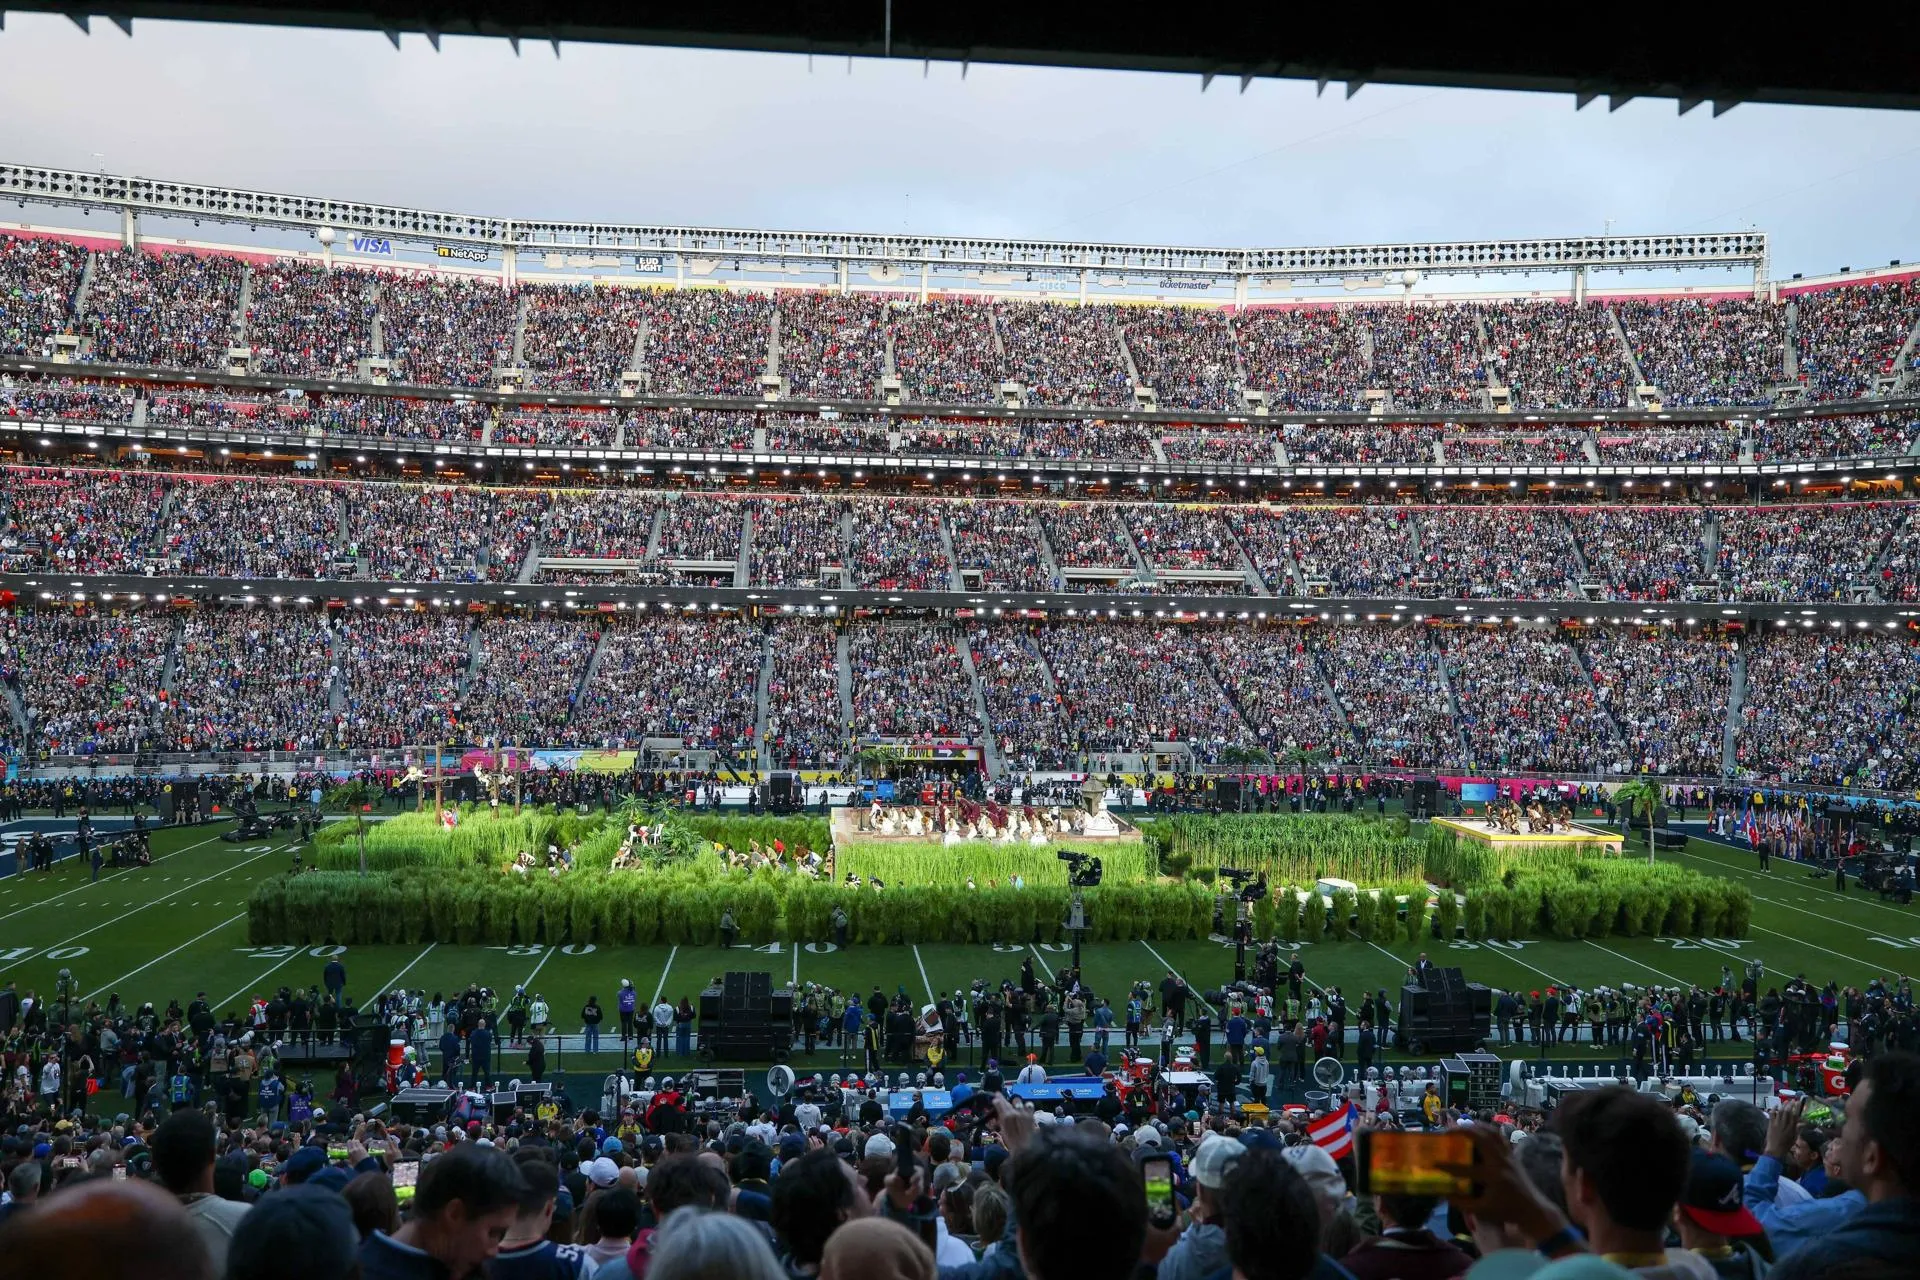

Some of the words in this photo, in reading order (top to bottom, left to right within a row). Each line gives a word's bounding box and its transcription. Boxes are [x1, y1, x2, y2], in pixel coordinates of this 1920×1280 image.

[353, 238, 392, 254] VISA
[450, 248, 488, 261] NetApp
[639, 257, 659, 265] BUD
[636, 264, 663, 272] LIGHT
[1160, 279, 1211, 290] ticketmaster
[908, 748, 931, 758] BOWL
[248, 945, 348, 958] 20
[507, 944, 597, 956] 30
[754, 942, 838, 953] 40
[1141, 1066, 1149, 1075] G
[1831, 1075, 1846, 1089] G
